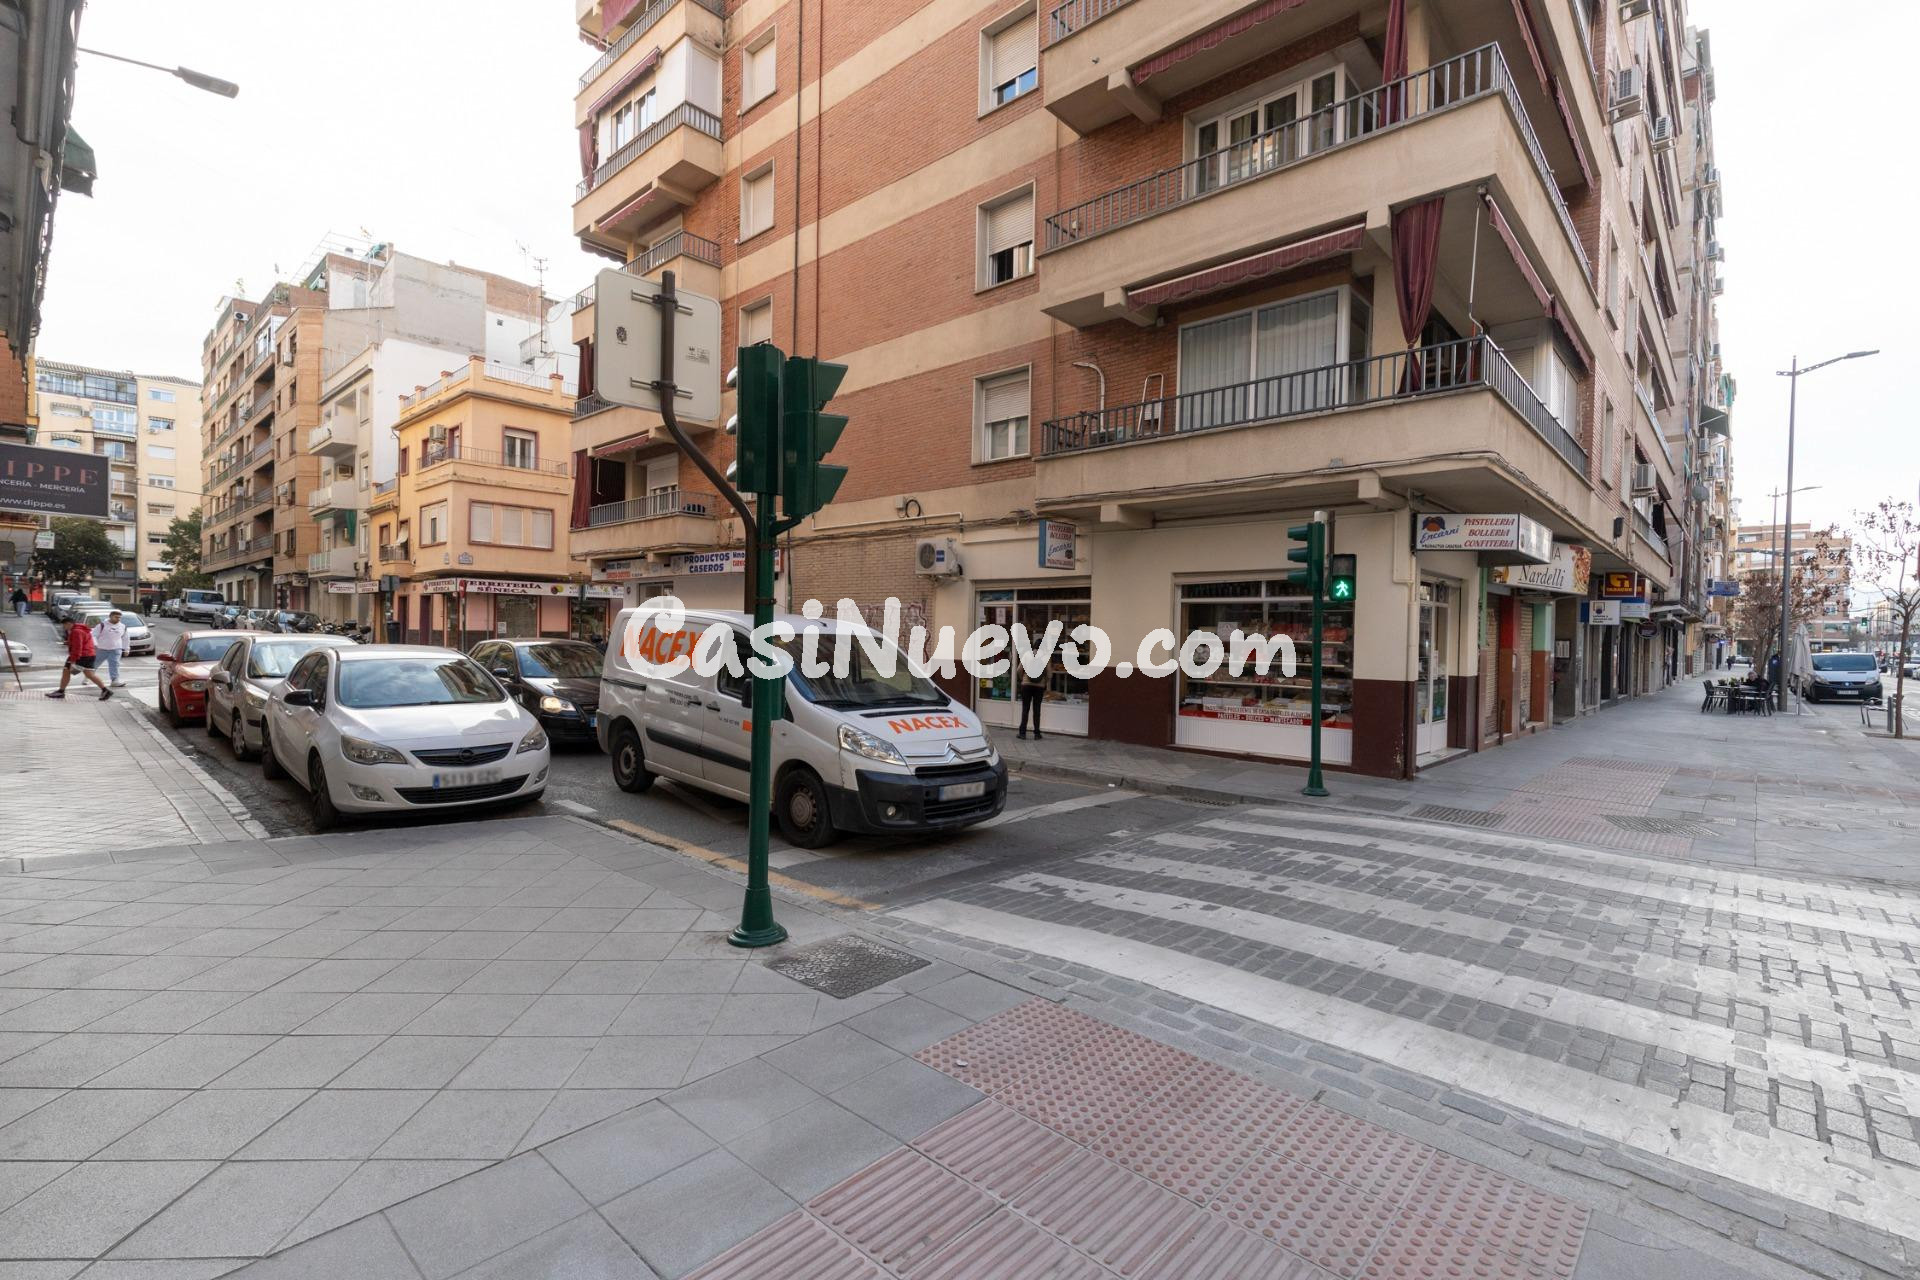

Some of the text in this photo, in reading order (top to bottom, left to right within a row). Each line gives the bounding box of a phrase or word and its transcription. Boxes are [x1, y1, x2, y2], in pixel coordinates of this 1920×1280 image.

[39, 484, 86, 494] MERCERÍA
[1463, 518, 1515, 526] PASTELERIA
[1419, 525, 1460, 544] Encarni
[1468, 529, 1511, 537] BOLLERIA
[1463, 540, 1514, 548] CONFITERIA
[683, 552, 730, 564] PRODUCTOS
[688, 563, 724, 573] CASEROS
[1517, 565, 1566, 587] Nardelli
[464, 580, 543, 589] ERRETERÍA
[477, 586, 528, 594] SÉNECA
[887, 716, 969, 735] NACEX
